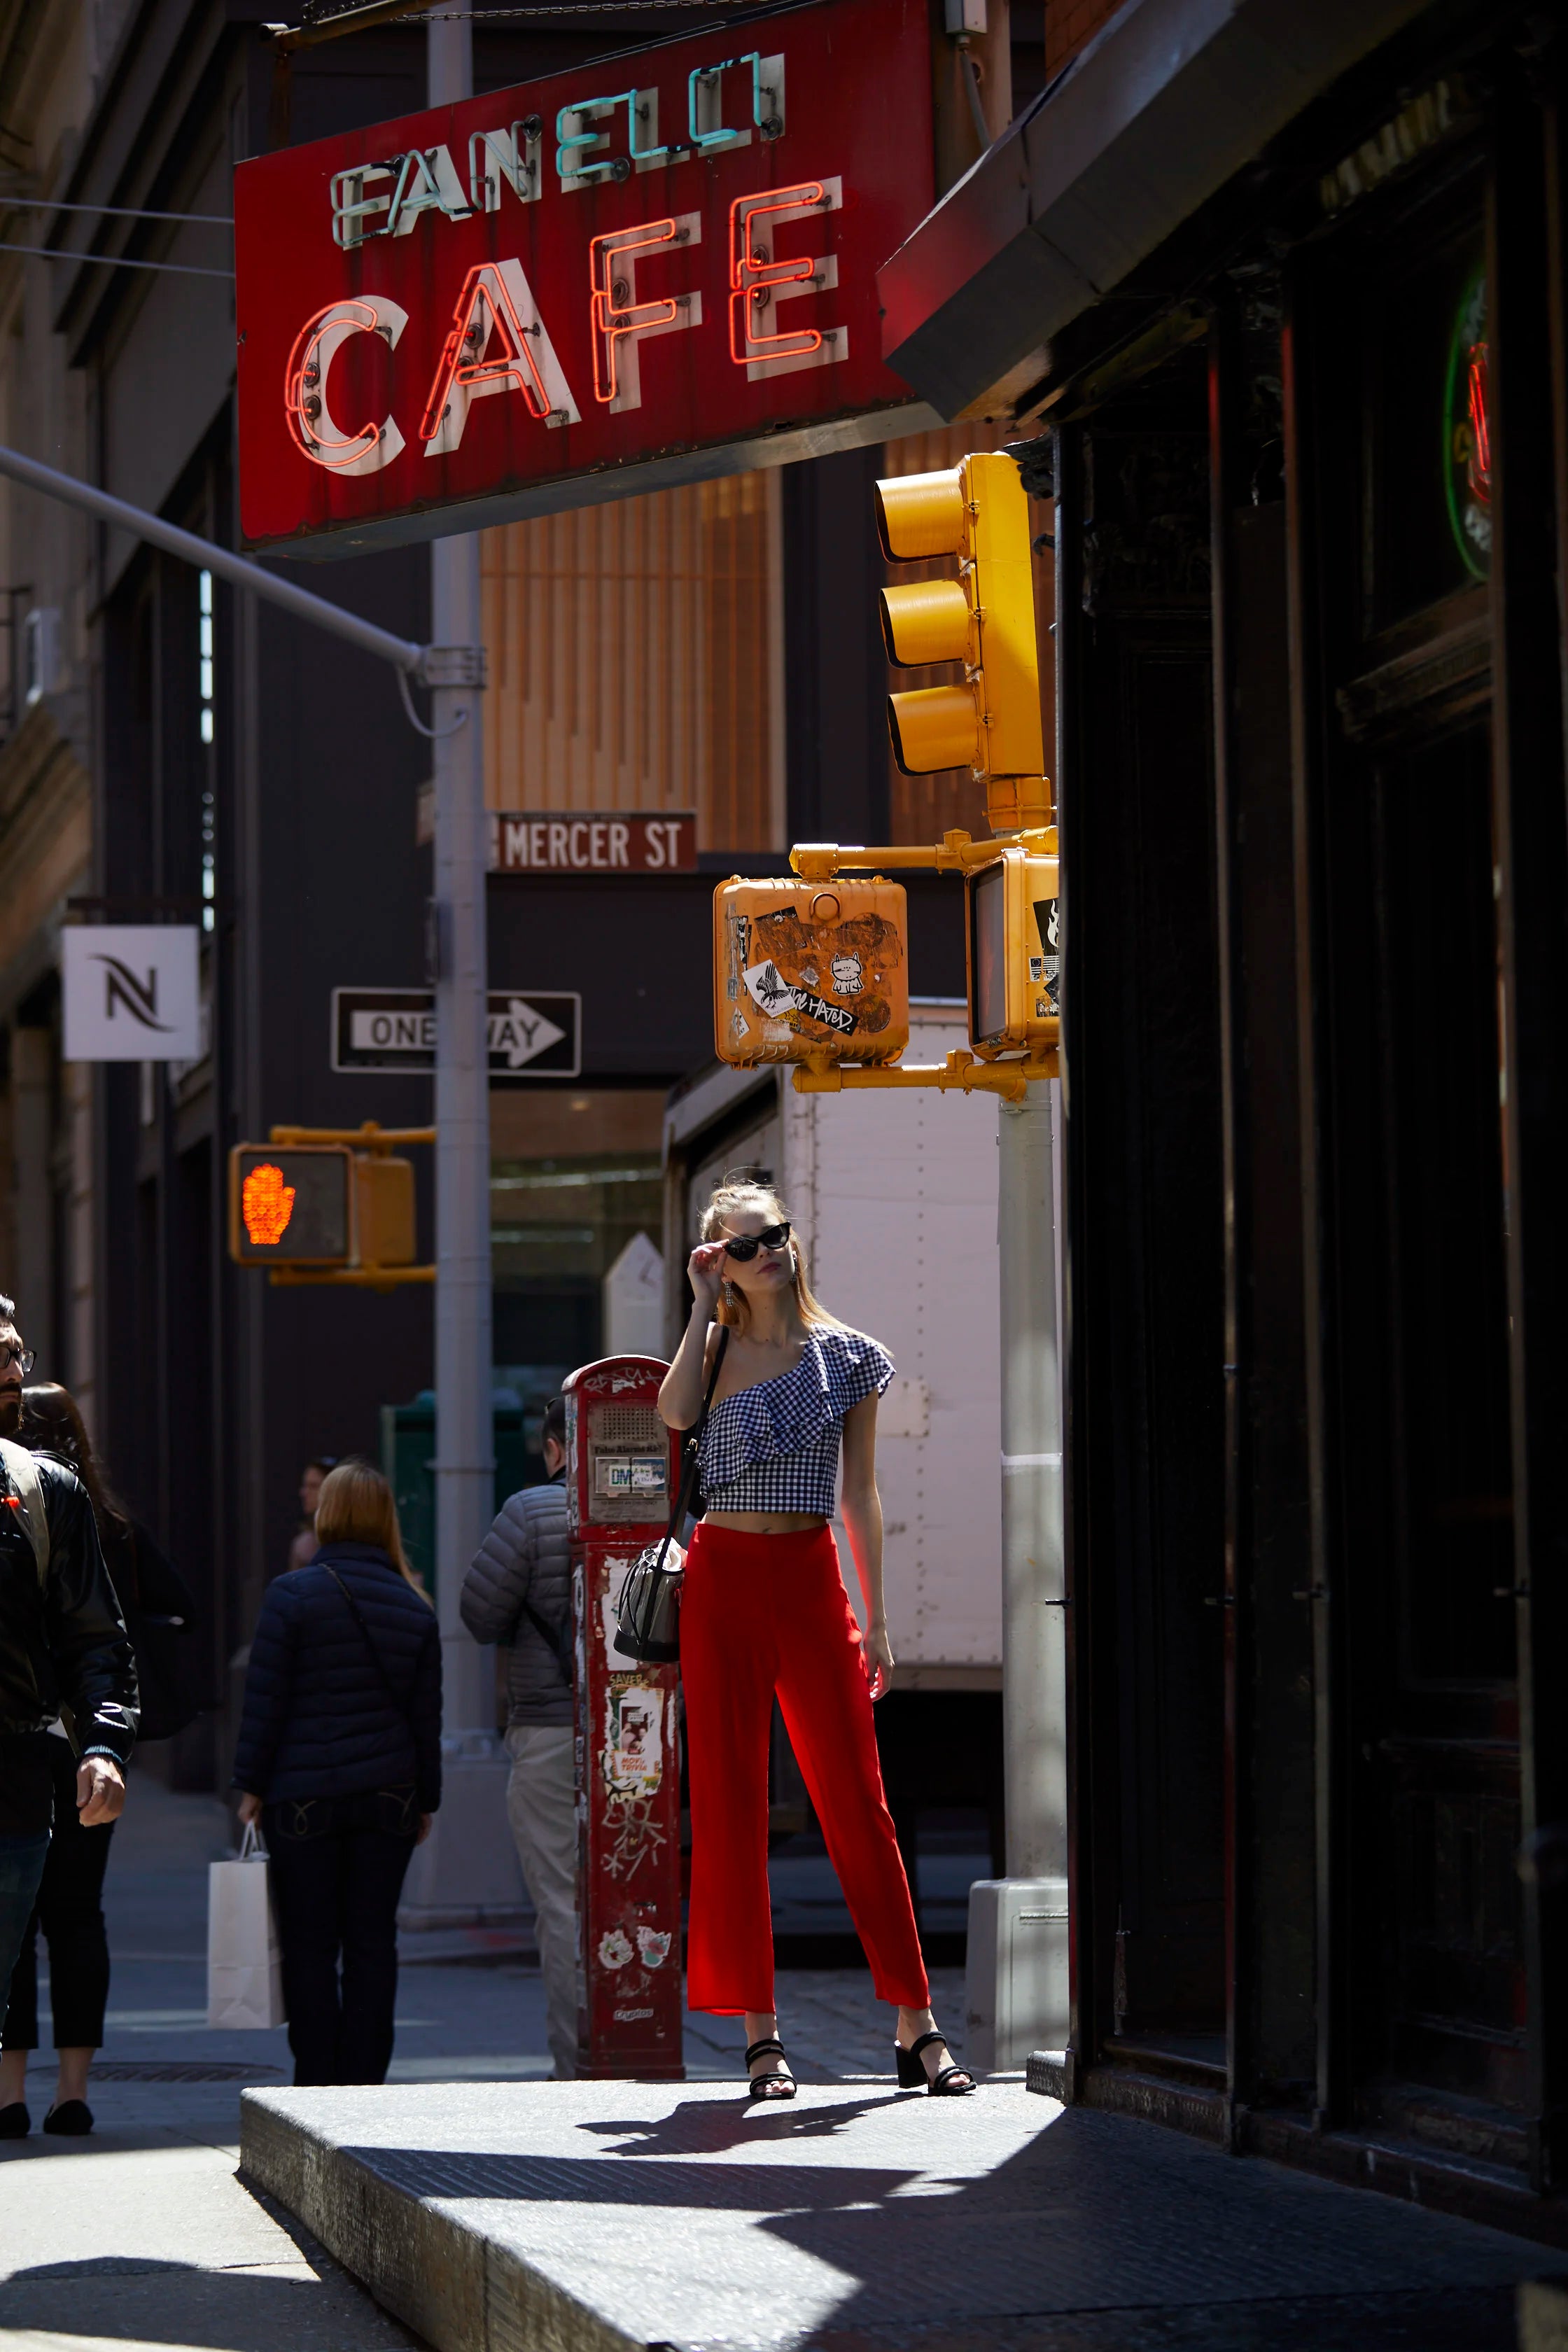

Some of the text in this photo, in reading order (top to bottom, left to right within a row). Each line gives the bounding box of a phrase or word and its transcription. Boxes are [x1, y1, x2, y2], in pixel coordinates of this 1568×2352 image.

[285, 175, 848, 476] CAFE
[505, 821, 682, 868] MERCER ST
[371, 1017, 437, 1046] ONE
